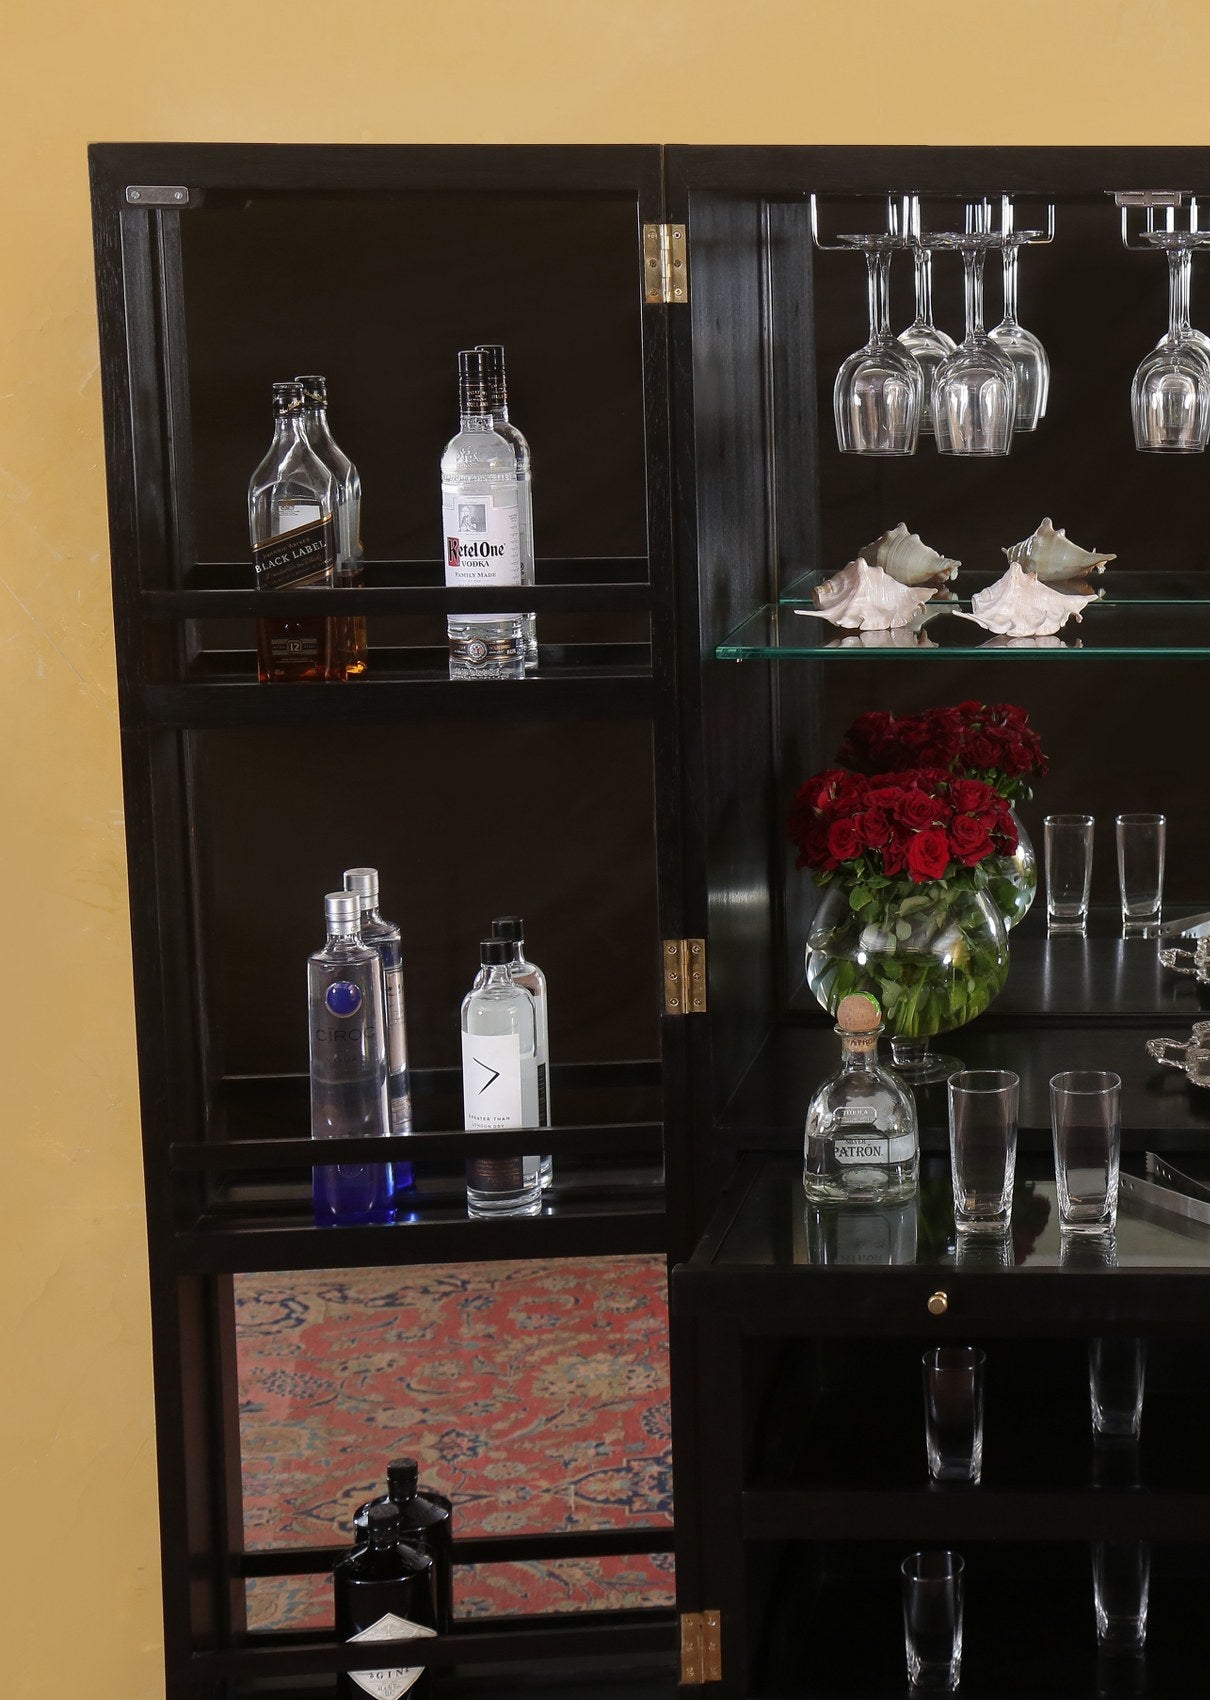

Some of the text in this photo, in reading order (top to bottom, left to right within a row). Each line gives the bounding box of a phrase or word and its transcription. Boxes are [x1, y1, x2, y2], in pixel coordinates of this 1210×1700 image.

[254, 553, 290, 573] BLACK
[292, 540, 327, 559] LABEL
[448, 538, 505, 562] Ketel One
[461, 560, 490, 568] VODKA
[290, 642, 300, 652] 12
[376, 1667, 404, 1680] GIN
